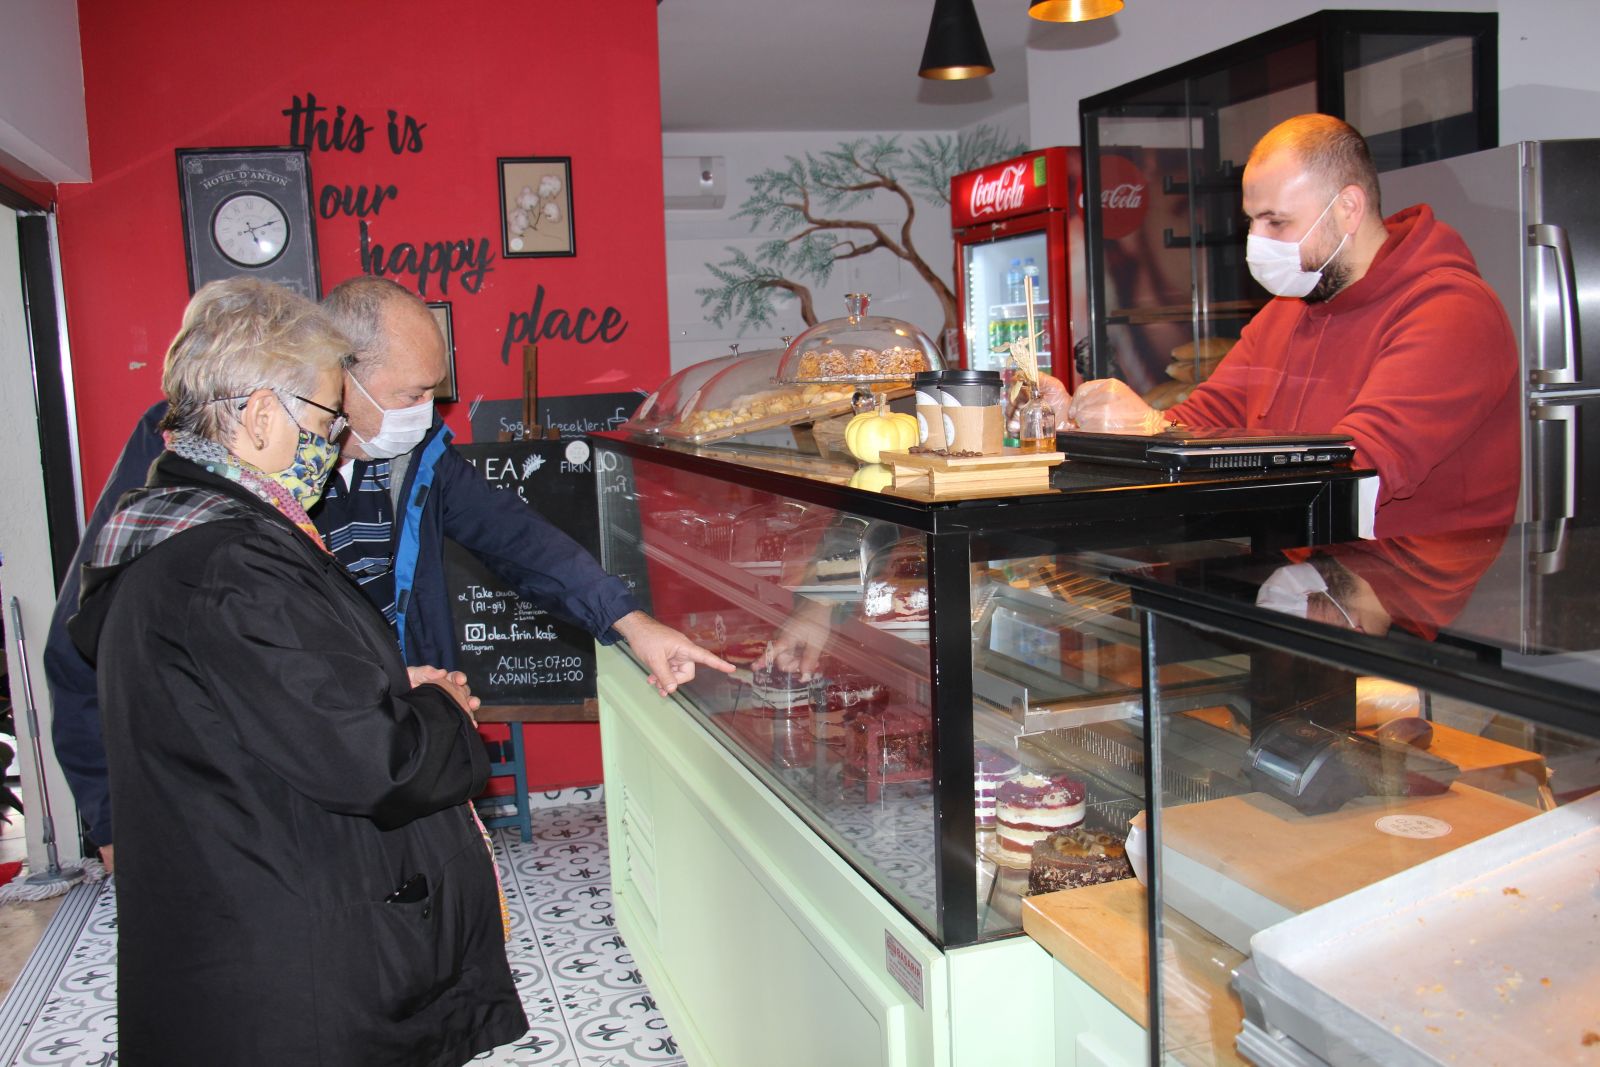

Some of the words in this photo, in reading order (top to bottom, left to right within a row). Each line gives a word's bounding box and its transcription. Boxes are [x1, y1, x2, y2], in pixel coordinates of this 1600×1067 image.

[282, 92, 374, 153] this
[387, 109, 428, 155] is
[203, 172, 235, 190] HOTEL
[239, 171, 289, 188] D'ANTON
[319, 183, 398, 220] our
[358, 219, 496, 296] happy
[501, 284, 628, 366] place
[467, 585, 494, 600] Take
[460, 642, 495, 656] instagram
